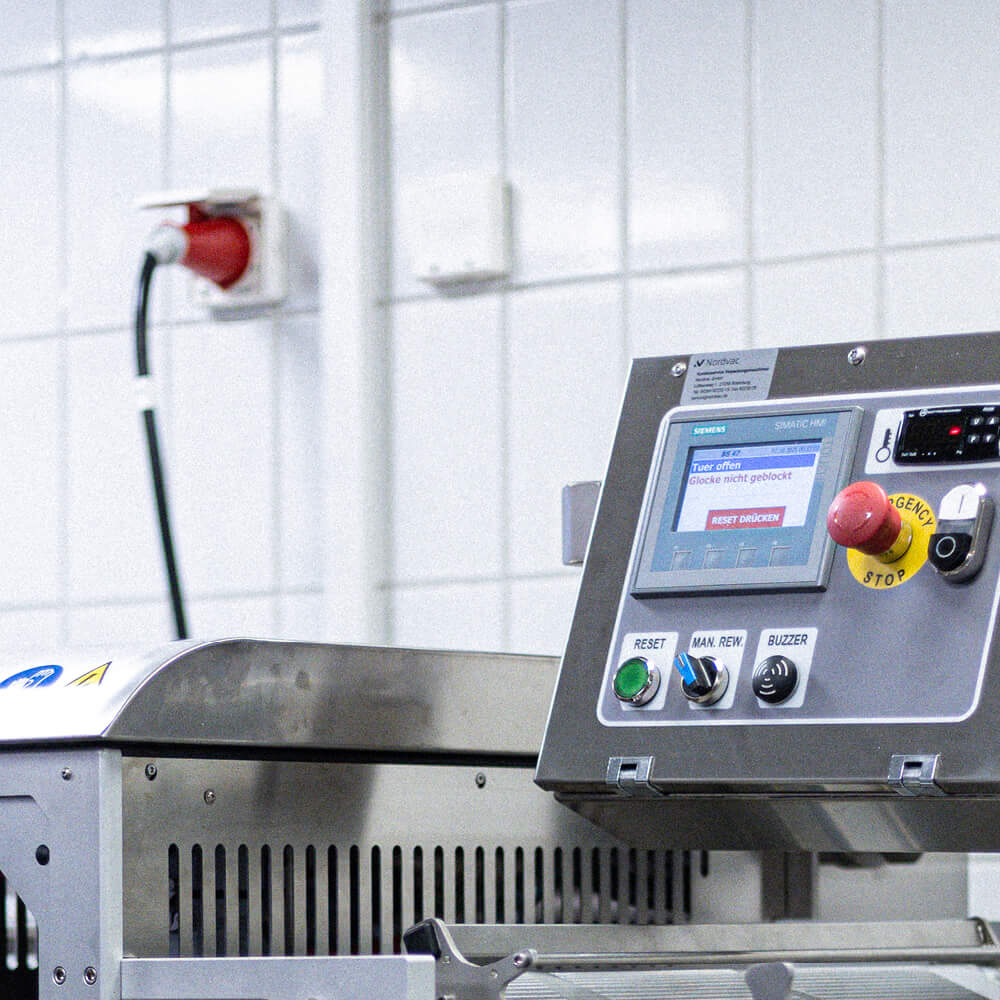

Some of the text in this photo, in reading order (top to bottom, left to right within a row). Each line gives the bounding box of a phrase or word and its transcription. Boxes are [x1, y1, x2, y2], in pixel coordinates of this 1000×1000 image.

[694, 425, 727, 435] SIEMENS
[774, 420, 808, 430] SIMATIC
[692, 461, 741, 472] Tuer offen
[688, 471, 793, 486] Glocke nicht geblockt
[889, 496, 934, 527] GENCY
[711, 513, 780, 525] RESET DRÜCKEN
[863, 569, 906, 586] STOP
[633, 638, 667, 650] RESET
[691, 635, 744, 648] MAN. REW.
[767, 634, 809, 647] BUZZER
